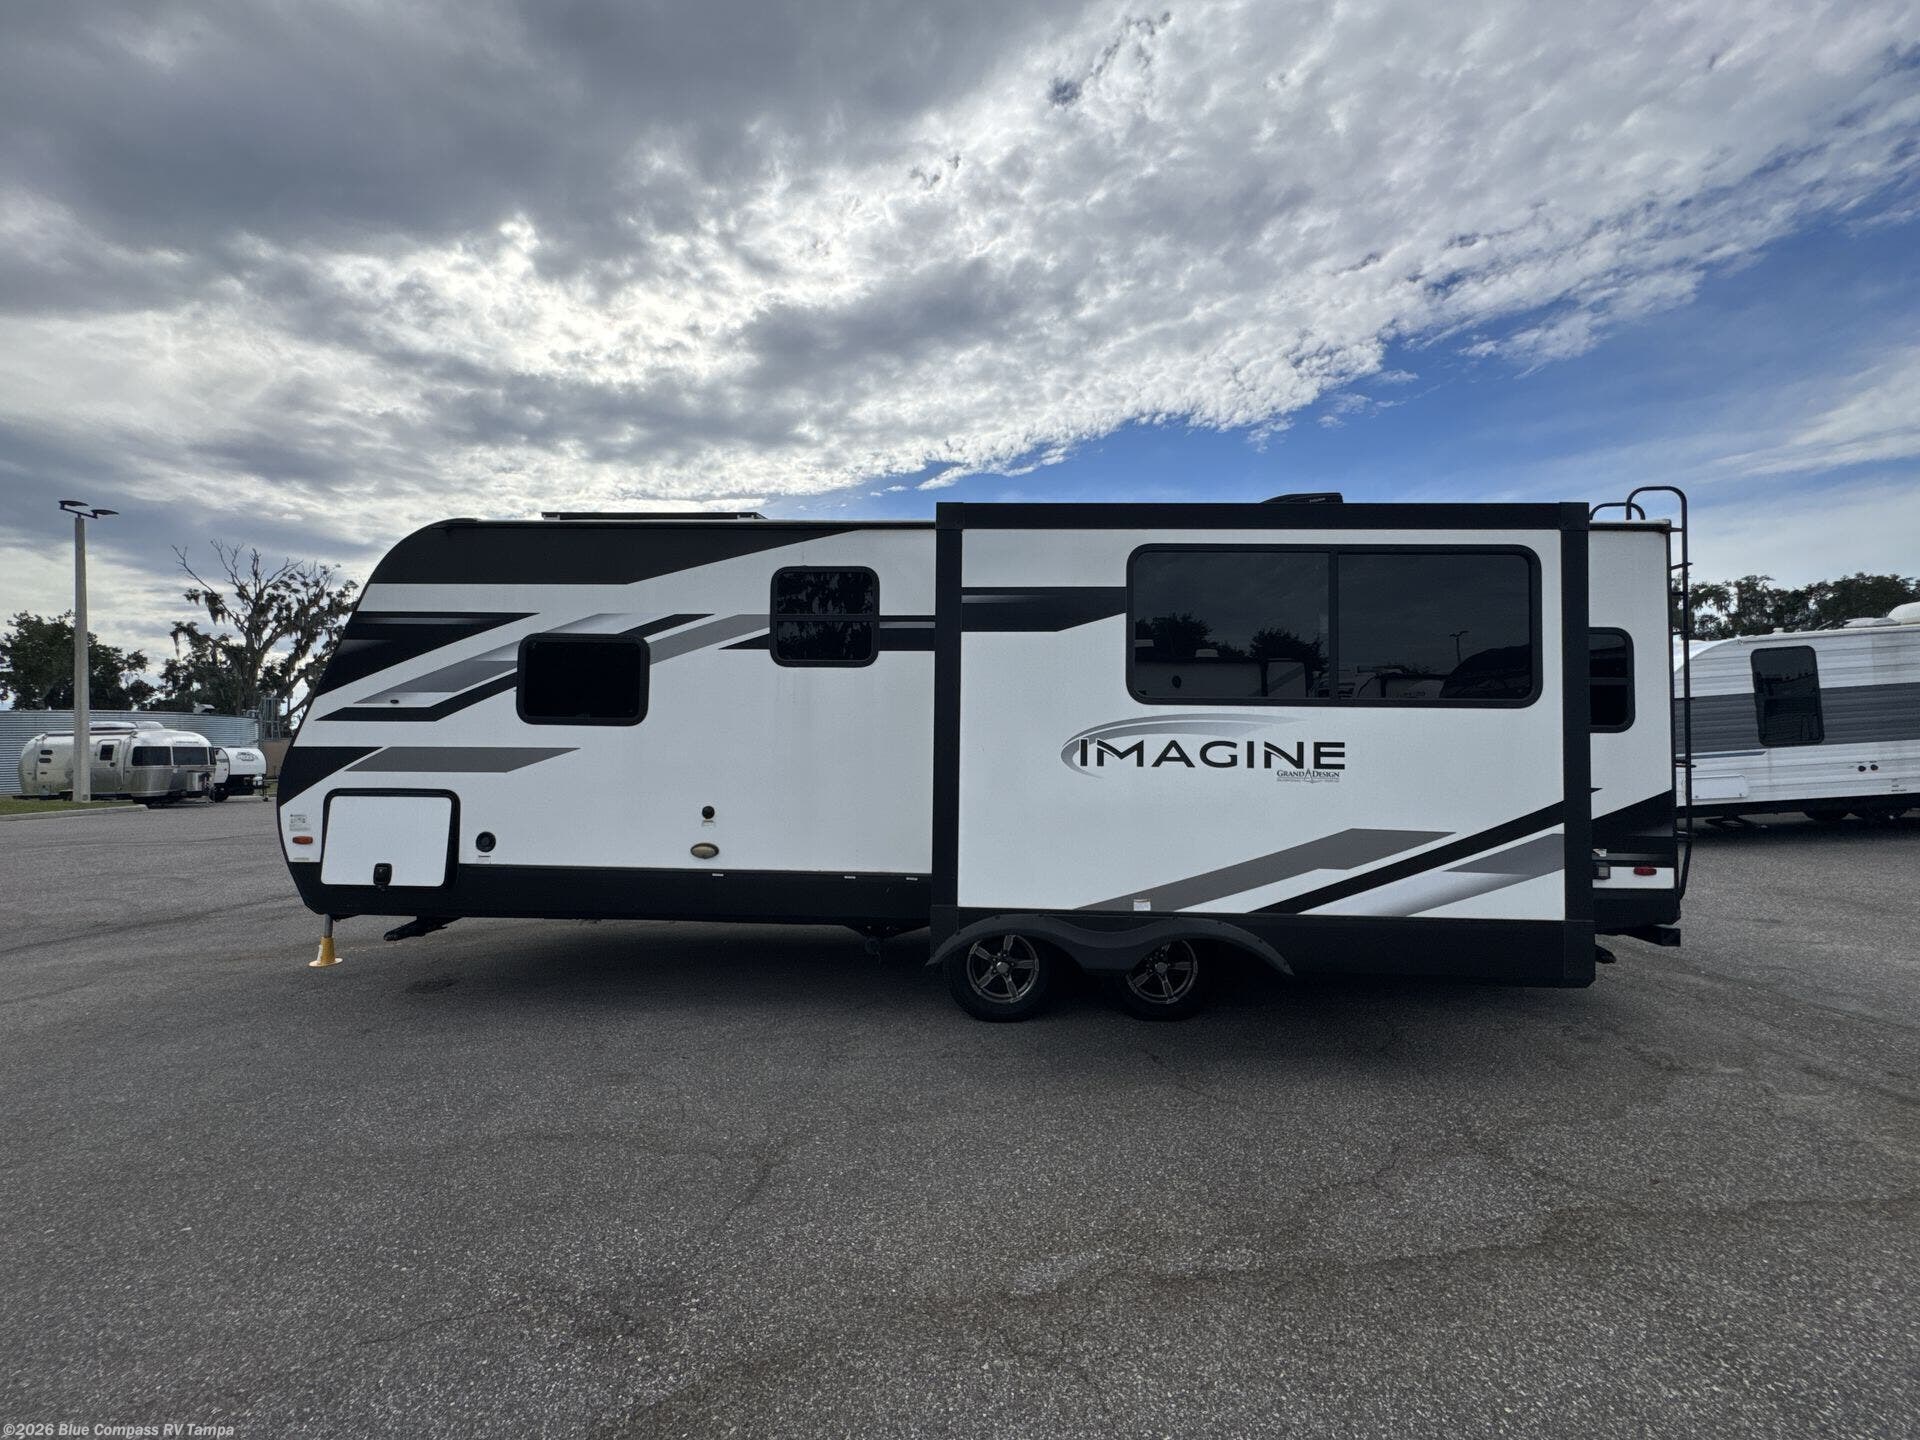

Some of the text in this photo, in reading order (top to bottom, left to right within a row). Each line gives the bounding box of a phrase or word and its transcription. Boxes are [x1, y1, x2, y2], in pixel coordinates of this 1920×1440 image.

[1079, 738, 1346, 770] IMAGINE
[1276, 769, 1341, 778] GRAND DESIGN
